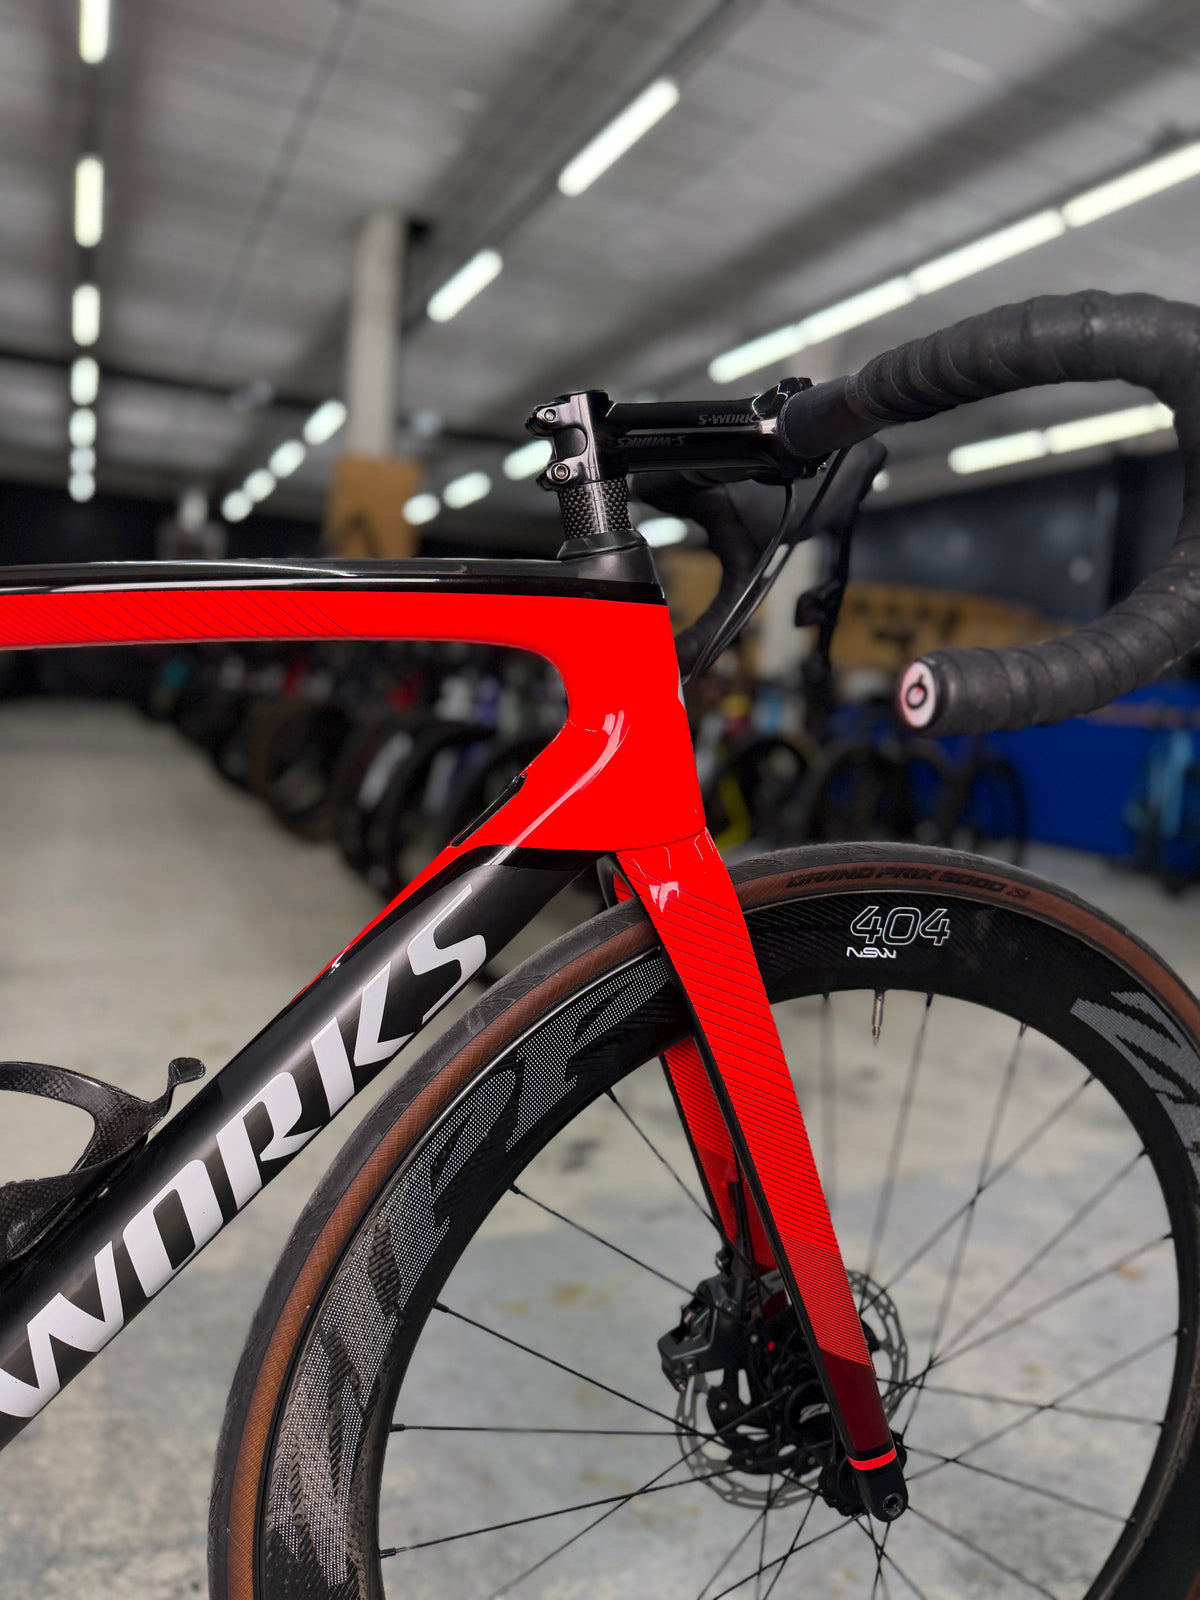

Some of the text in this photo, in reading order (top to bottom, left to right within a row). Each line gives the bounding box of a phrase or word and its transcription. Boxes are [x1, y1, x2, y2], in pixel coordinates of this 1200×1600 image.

[698, 412, 766, 425] S-WORKS
[616, 435, 686, 448] S-WORKS
[787, 867, 876, 888] GRAND
[876, 866, 936, 881] PRIX
[939, 871, 1008, 892] 5000
[850, 905, 950, 946] 404
[846, 946, 897, 959] NSW
[0, 884, 487, 1418] WORKS
